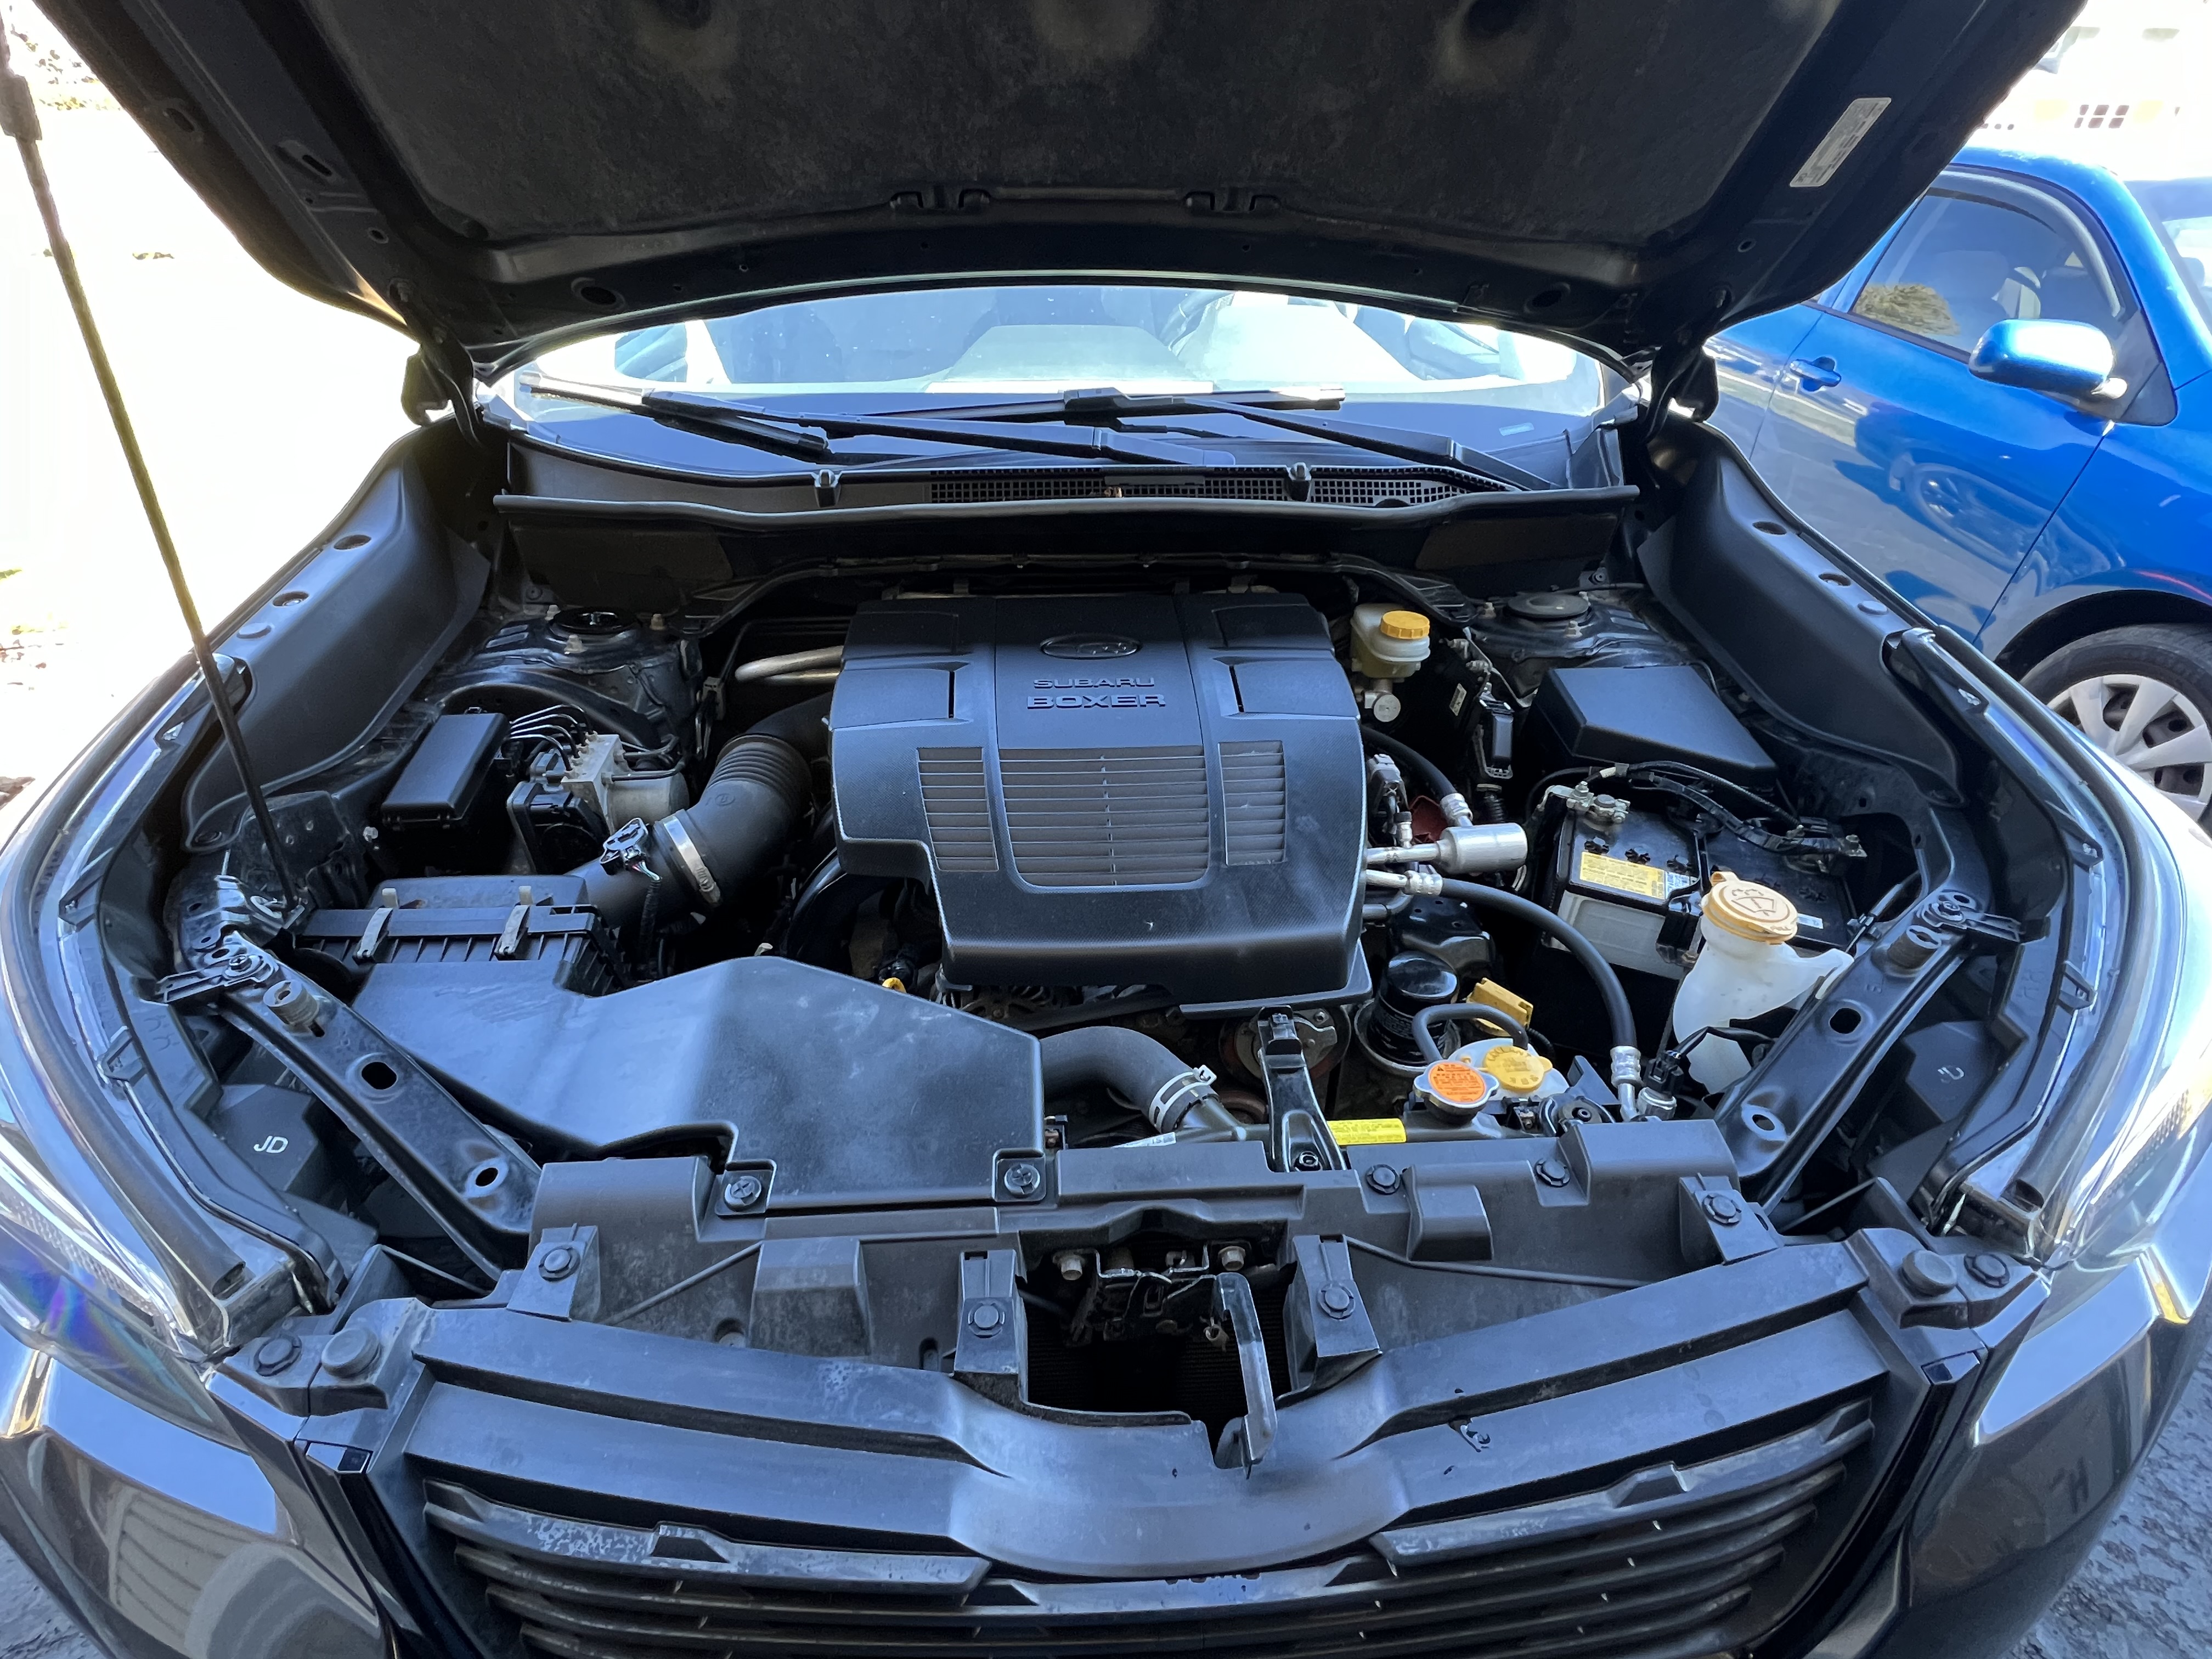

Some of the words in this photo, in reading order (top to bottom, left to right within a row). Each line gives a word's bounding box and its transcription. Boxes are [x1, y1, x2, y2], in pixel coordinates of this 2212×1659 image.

[1034, 678, 1155, 689] SUBARU
[1027, 694, 1166, 710] BOXER
[253, 1135, 289, 1153] JD
